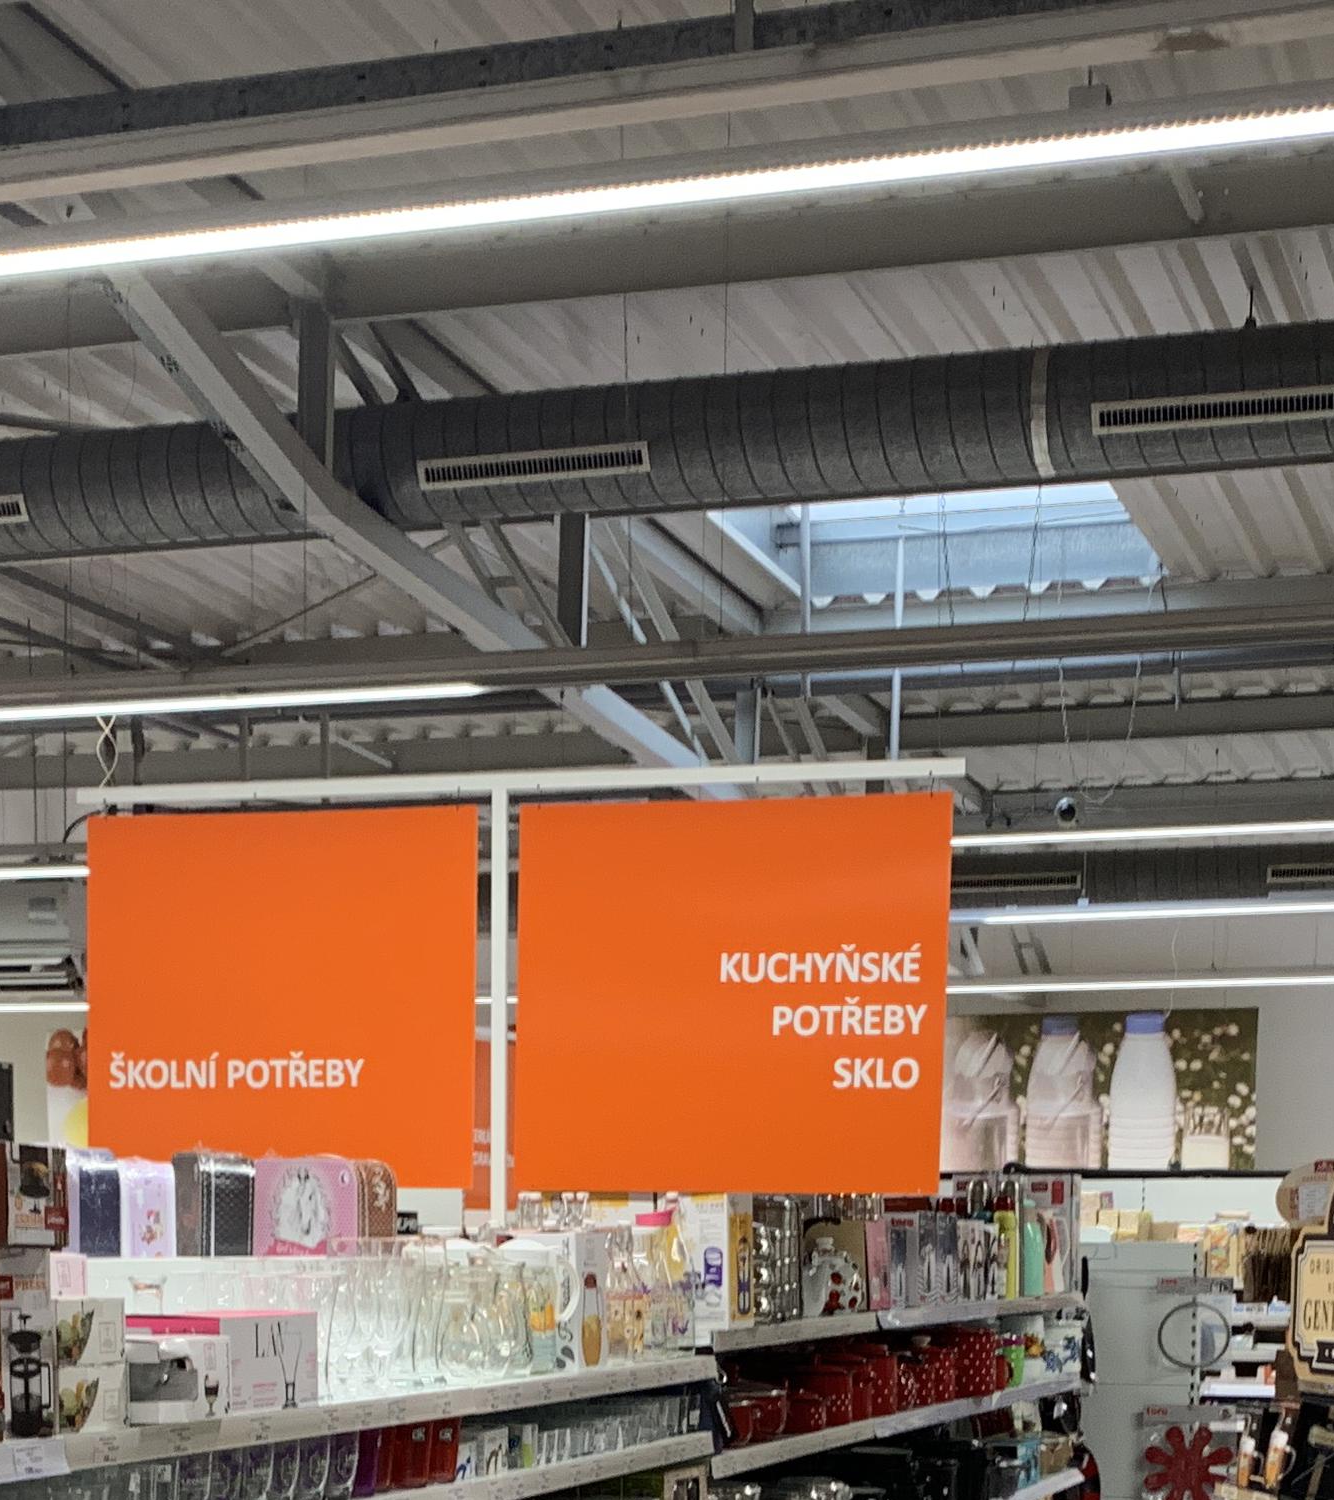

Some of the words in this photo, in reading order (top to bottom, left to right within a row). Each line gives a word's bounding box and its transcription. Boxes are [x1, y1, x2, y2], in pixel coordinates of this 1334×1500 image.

[719, 943, 922, 985] KUCHYŇSKÉ
[772, 995, 928, 1037] POTŘEBY
[109, 1050, 218, 1090] ŠKOLNÍ
[227, 1048, 365, 1090] POTŘEBY
[832, 1057, 920, 1090] SKLO
